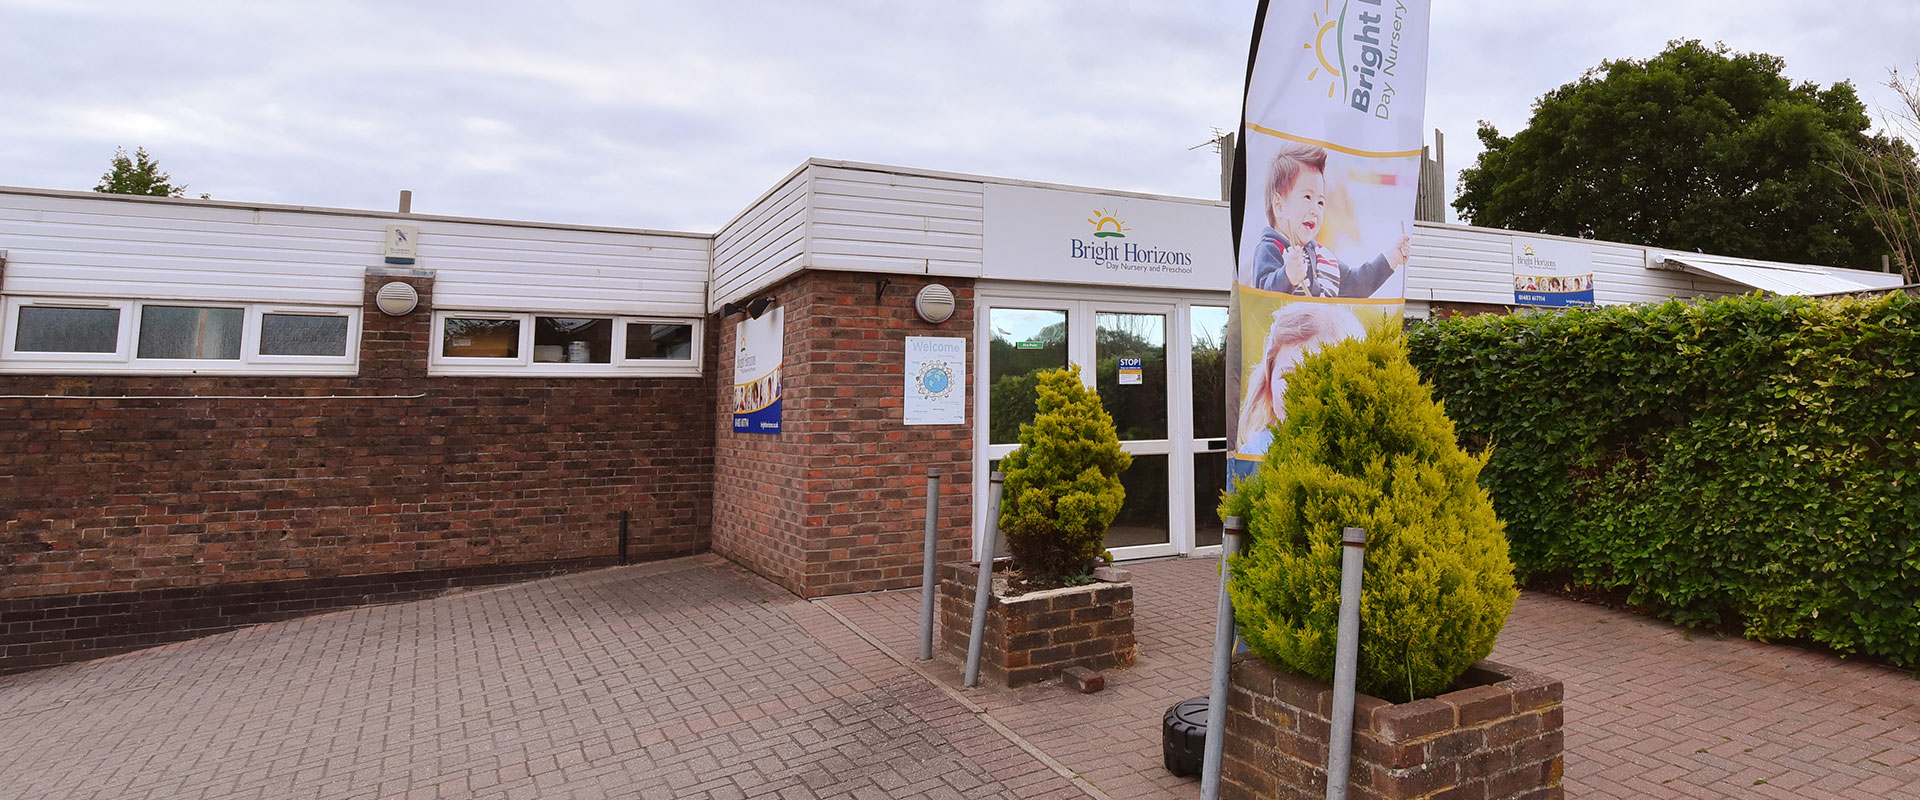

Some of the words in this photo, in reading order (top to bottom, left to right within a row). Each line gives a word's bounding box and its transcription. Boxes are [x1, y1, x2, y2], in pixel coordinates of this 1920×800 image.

[1383, 0, 1407, 77] Nursery
[1351, 11, 1383, 113] Bright
[1375, 81, 1396, 120] Day
[1071, 239, 1119, 265] Bright
[1124, 243, 1192, 266] Horizons
[1106, 262, 1119, 271] Day
[1121, 263, 1147, 273] Nursery
[1162, 265, 1192, 274] Preschool
[912, 341, 960, 352] Welcome
[1120, 358, 1141, 366] STOP!
